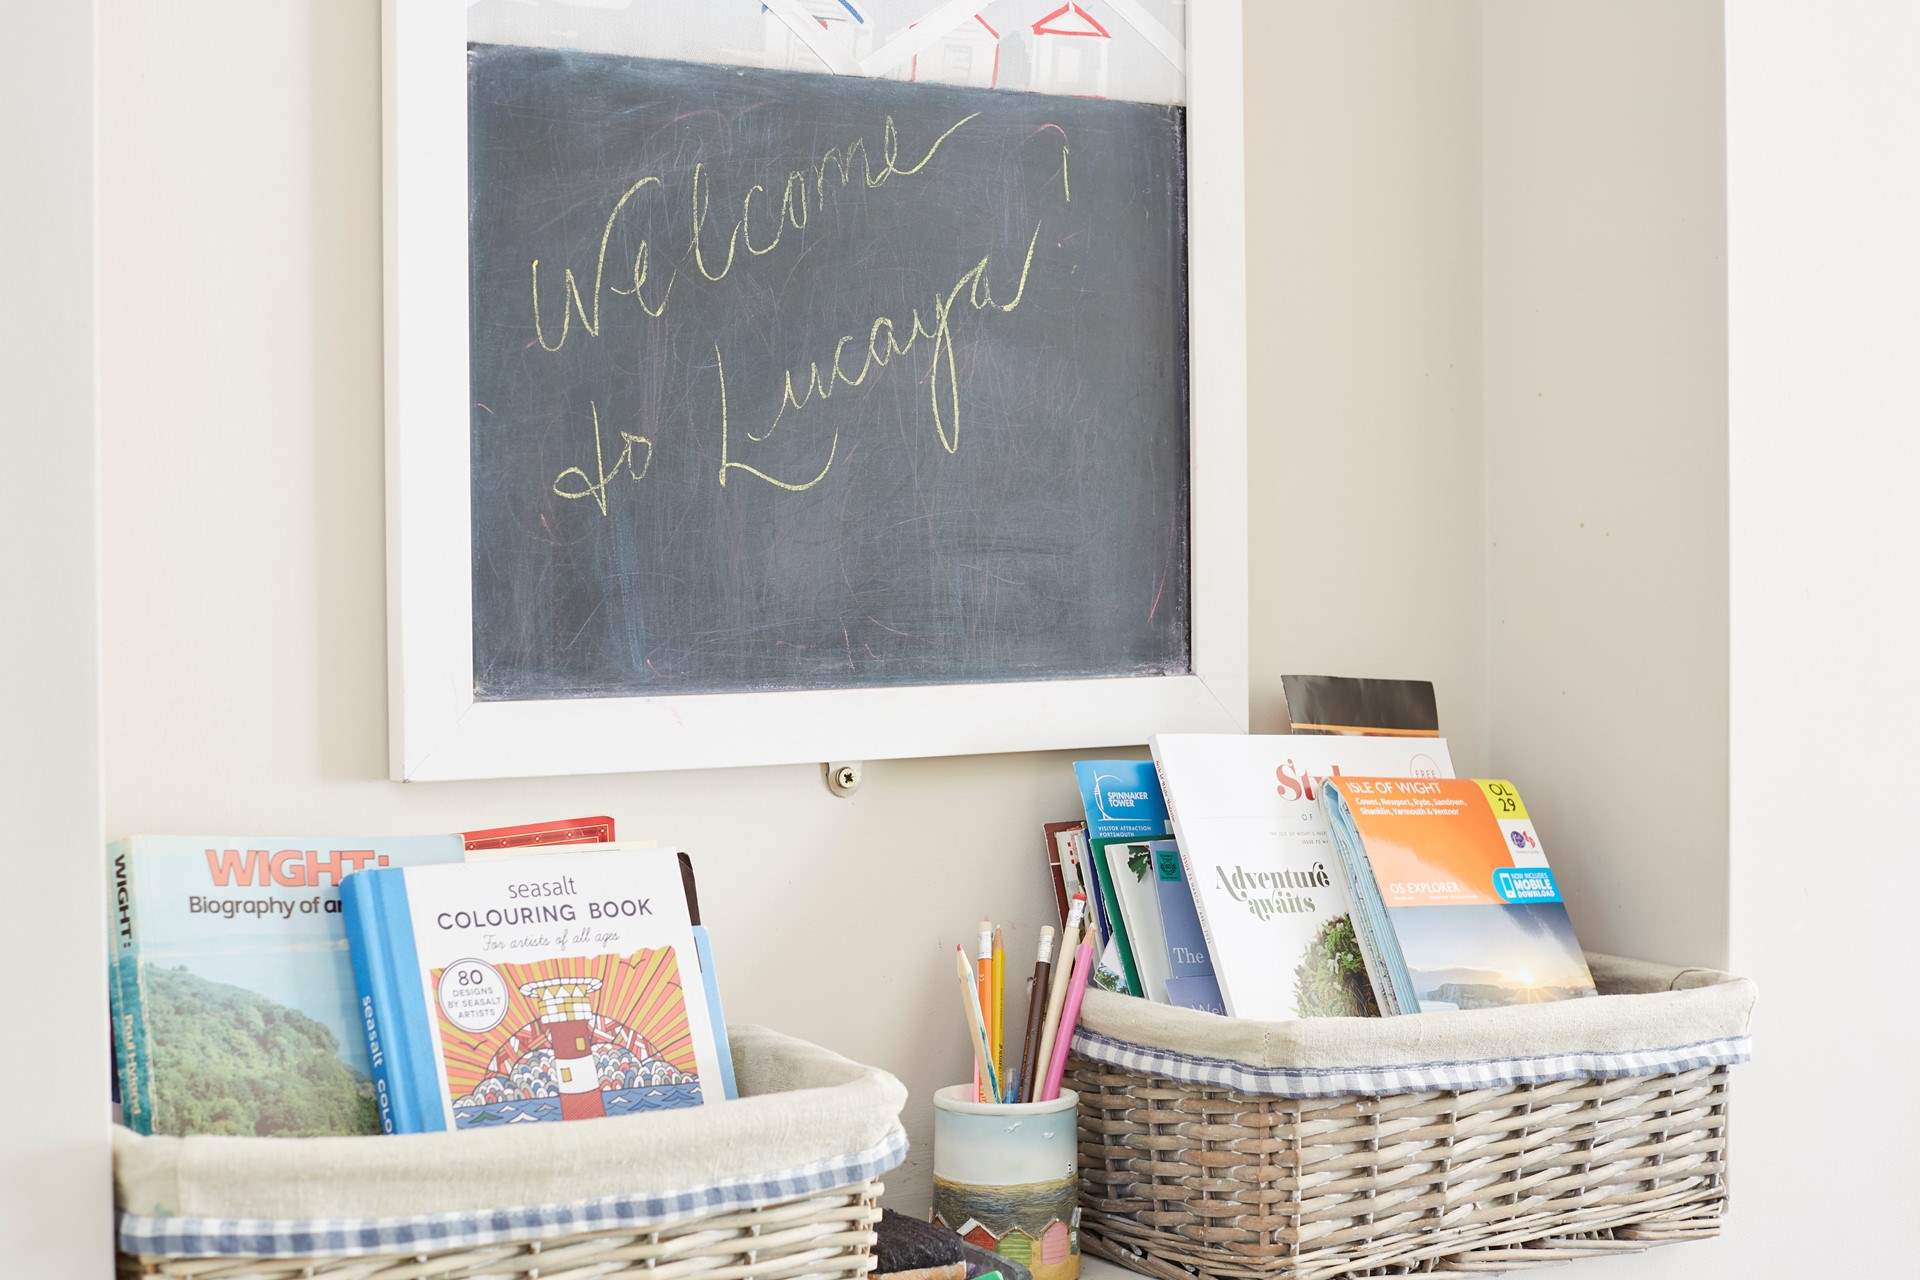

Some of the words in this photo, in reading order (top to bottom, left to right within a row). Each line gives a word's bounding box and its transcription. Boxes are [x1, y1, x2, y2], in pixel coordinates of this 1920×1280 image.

[529, 111, 981, 352] Welcome
[553, 400, 653, 517] to
[713, 218, 1042, 492] Lucaya
[1107, 791, 1149, 800] SPINNAKER
[1345, 781, 1375, 794] ISLE
[1375, 781, 1393, 794] OF
[1396, 781, 1442, 794] WIGHT
[1488, 783, 1513, 796] OL
[1108, 799, 1136, 808] TOWER
[1498, 798, 1516, 812] 29
[508, 875, 578, 899] seasalt
[1215, 861, 1330, 902] Adventure
[1389, 882, 1405, 894] OS
[1407, 881, 1460, 894] EXPLORER
[1513, 879, 1553, 891] MOBILE
[114, 854, 132, 948] WIGHT:
[1516, 889, 1556, 898] DOWNLOAD
[189, 896, 295, 919] Biography
[298, 896, 321, 914] of
[437, 904, 577, 930] COLOURING
[588, 898, 653, 920] BOOK
[1248, 889, 1316, 922] awaits
[482, 933, 506, 952] For
[510, 933, 551, 949] artists
[555, 928, 569, 951] of
[572, 927, 591, 944] all
[594, 930, 621, 949] ages
[1172, 947, 1205, 964] The
[458, 969, 483, 986] 80
[452, 986, 494, 998] DESIGNS
[447, 1000, 459, 1009] BY
[461, 997, 501, 1008] SEASALT
[458, 1008, 496, 1018] ARTISTS
[362, 995, 384, 1068] seasalt
